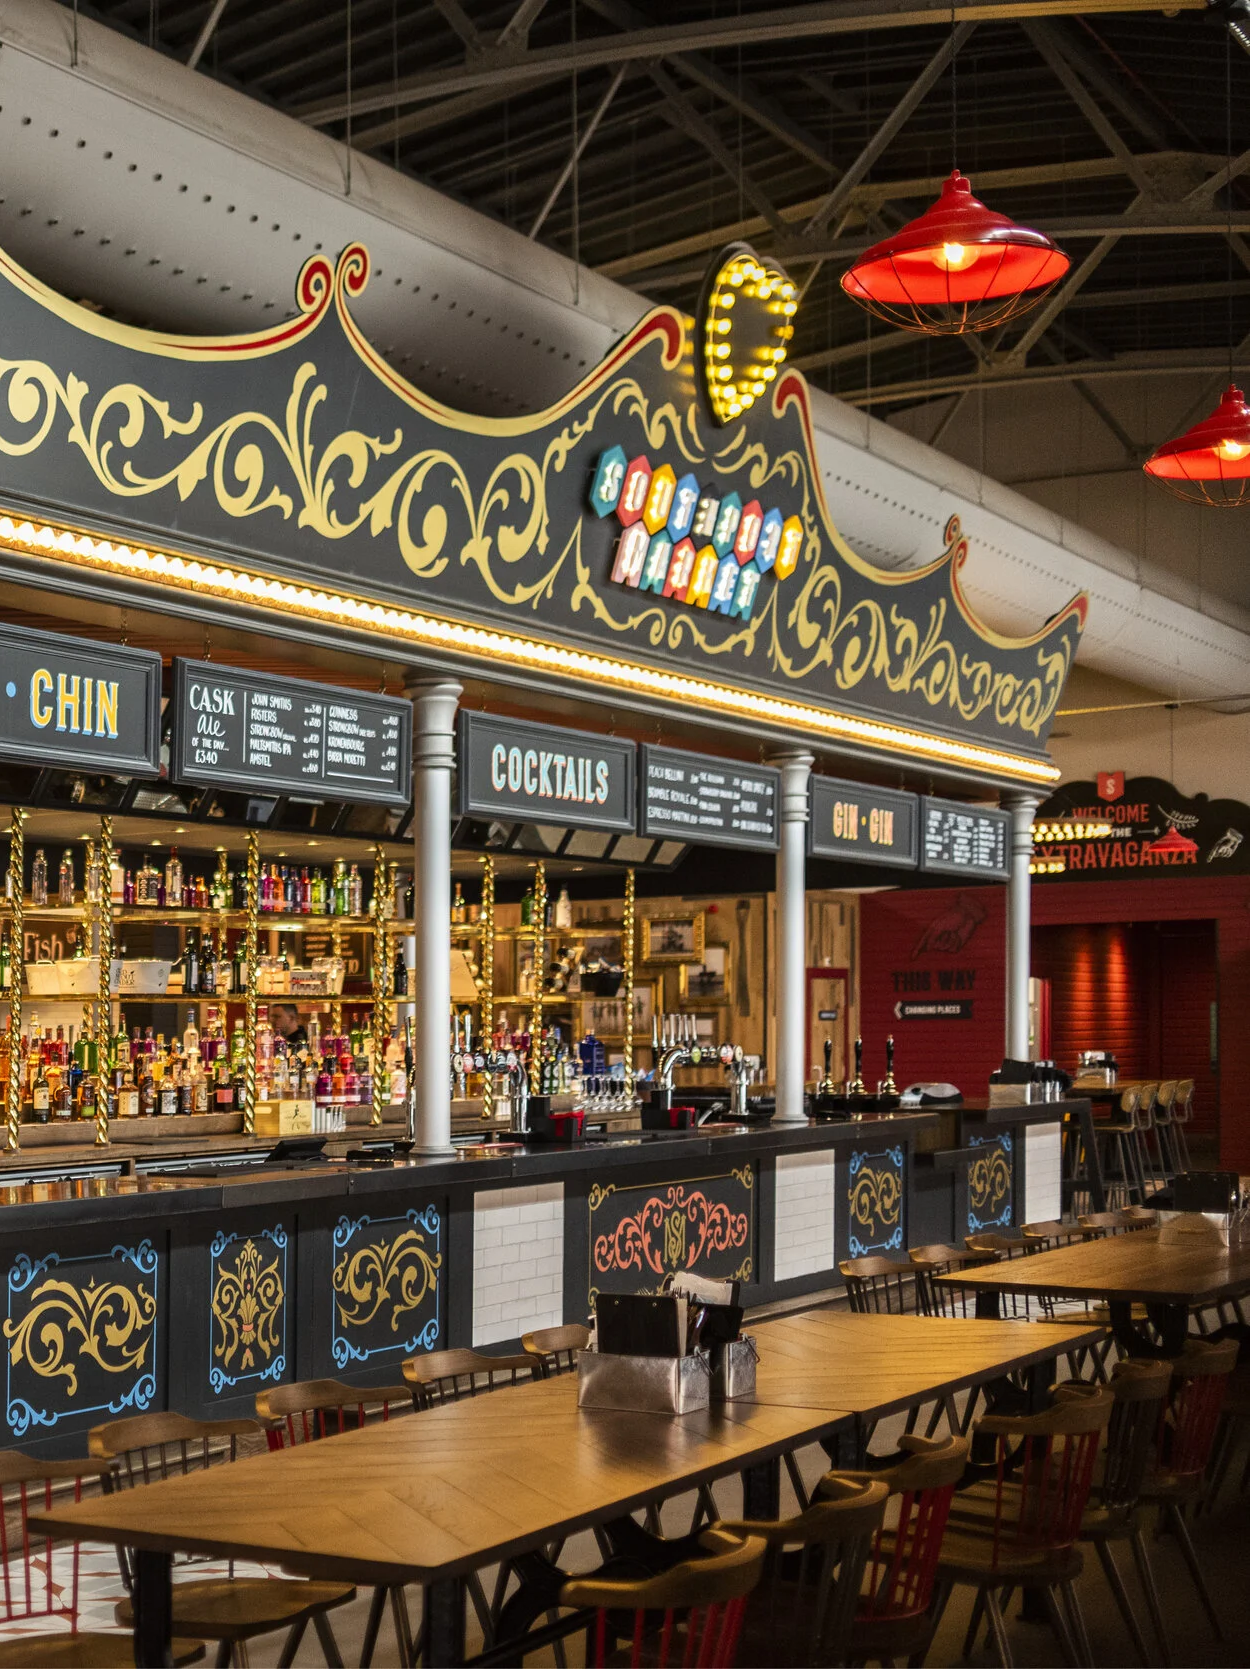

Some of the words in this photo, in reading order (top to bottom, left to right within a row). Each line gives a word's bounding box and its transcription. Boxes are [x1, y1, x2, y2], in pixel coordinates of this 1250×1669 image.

[600, 461, 803, 571] SOUTHPORT
[621, 528, 762, 609] MARKET
[30, 668, 119, 739] CHIN
[189, 684, 235, 716] CASK
[252, 693, 269, 707] JOHN
[329, 705, 358, 721] GUINNESS
[251, 708, 277, 723] FOSTERS
[191, 737, 200, 747] OF
[201, 738, 212, 749] THE
[250, 723, 284, 739] STRONGBOW
[491, 743, 609, 804] COCKTAILS
[832, 801, 859, 841] GIN
[868, 807, 894, 846] GIN
[23, 932, 63, 962] Fish
[892, 971, 931, 992] THIS
[937, 969, 976, 991] WAY
